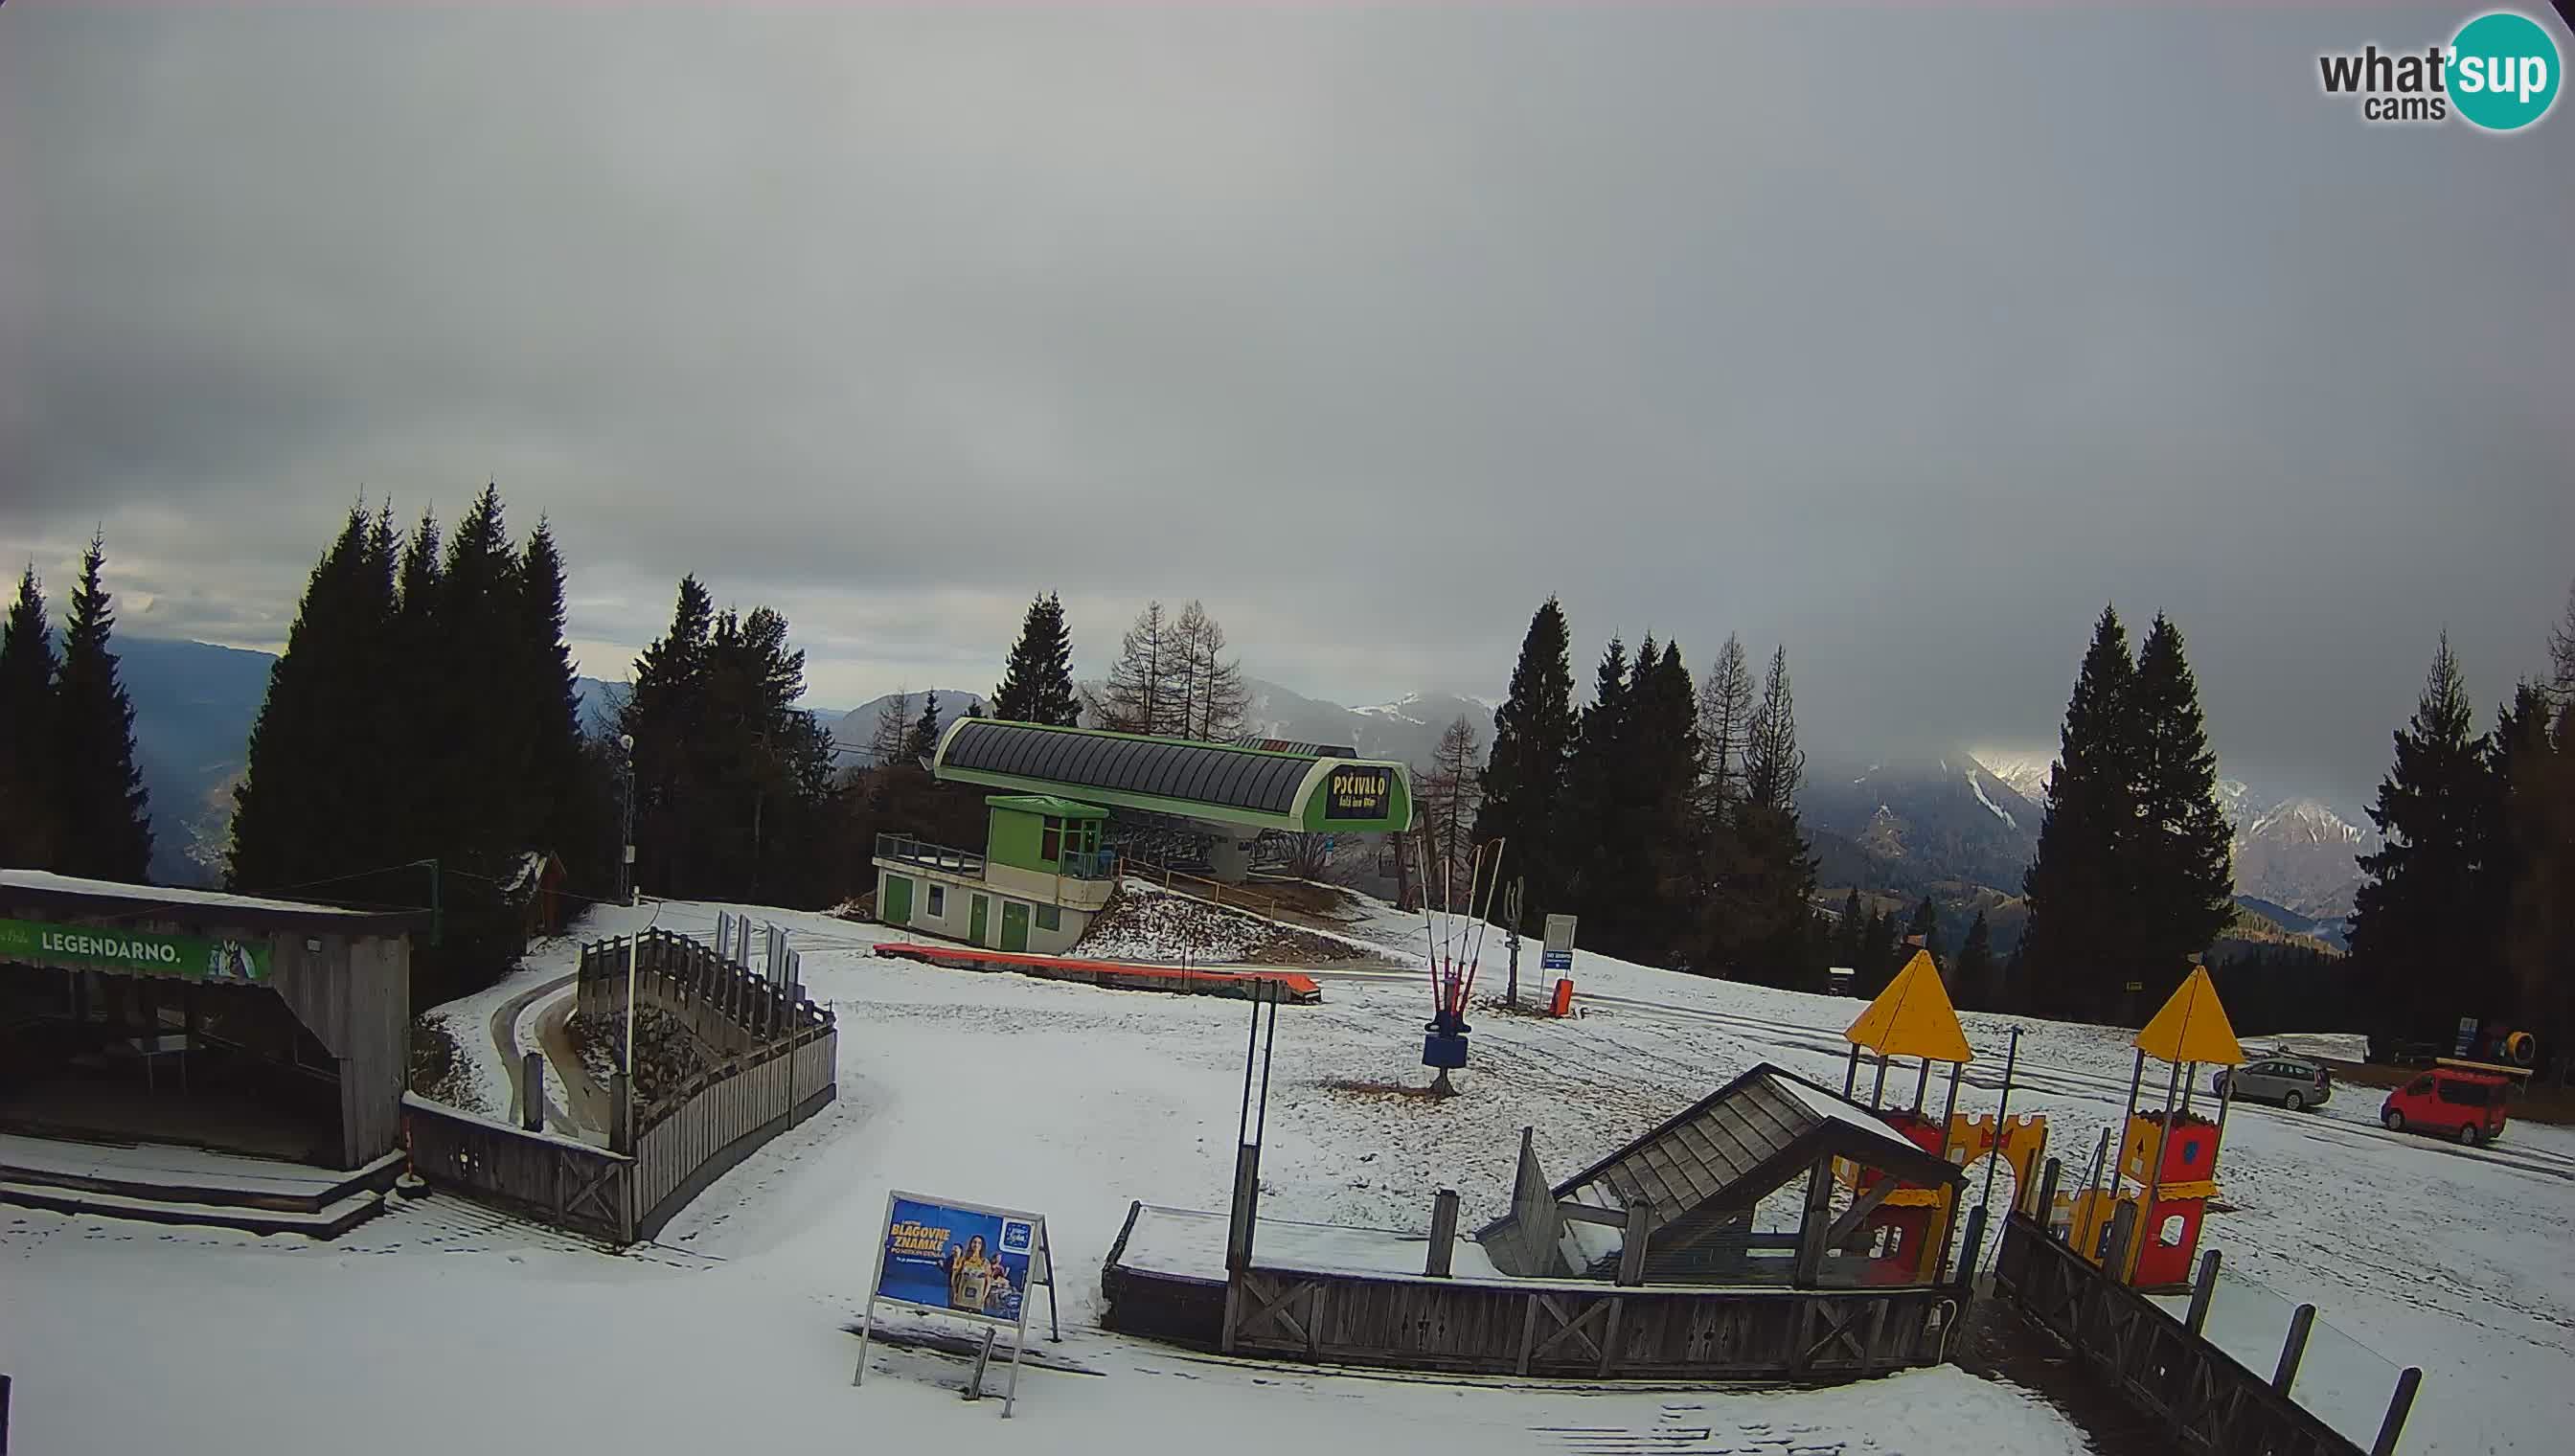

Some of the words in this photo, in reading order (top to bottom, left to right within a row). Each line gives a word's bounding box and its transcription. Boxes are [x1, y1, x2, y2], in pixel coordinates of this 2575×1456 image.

[41, 931, 181, 964] LEGENDARNO.
[891, 1223, 951, 1241] BLAGOVNE
[894, 1236, 945, 1252] ZNAMKE
